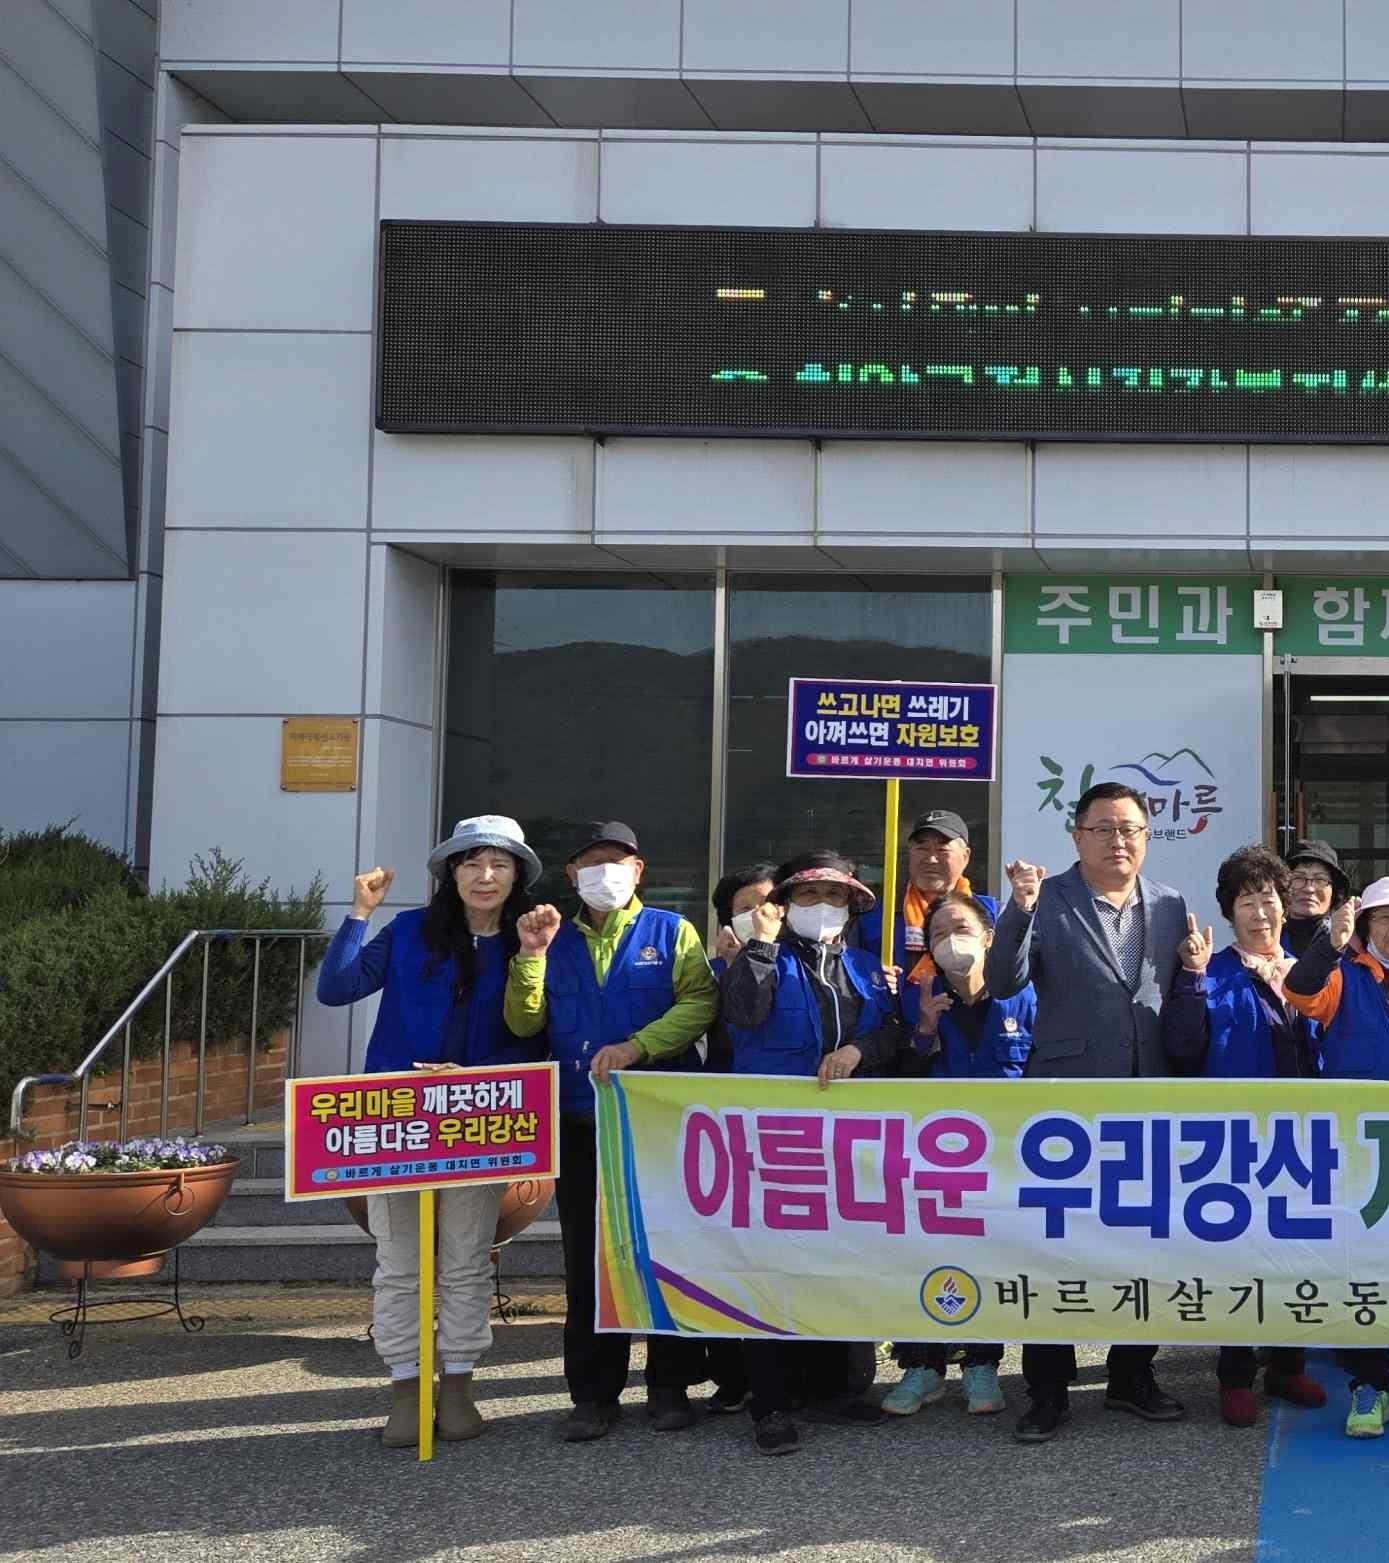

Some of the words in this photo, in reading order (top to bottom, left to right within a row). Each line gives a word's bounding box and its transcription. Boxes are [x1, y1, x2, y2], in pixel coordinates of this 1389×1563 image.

[1036, 585, 1234, 646] 주민과
[816, 692, 900, 719] 쓰고나면
[907, 695, 969, 720] 쓰레기
[805, 720, 889, 746] 아껴쓰면
[896, 723, 980, 747] 자원보호
[831, 755, 860, 766] 바르게
[906, 757, 934, 767] 대치면
[311, 1086, 416, 1124] 우리마을
[422, 1079, 524, 1115] 깨끗하게
[325, 1119, 431, 1157] 아름다운
[438, 1112, 539, 1148] 우리강산
[345, 1167, 382, 1179] 바르게
[390, 1162, 438, 1175] 살기운동
[446, 1159, 481, 1172] 대치면
[487, 1155, 523, 1169] 위원회
[682, 1110, 991, 1237] 아름다운
[1018, 1115, 1339, 1242] 우리강산
[995, 1273, 1388, 1326] 바르게살기운동
